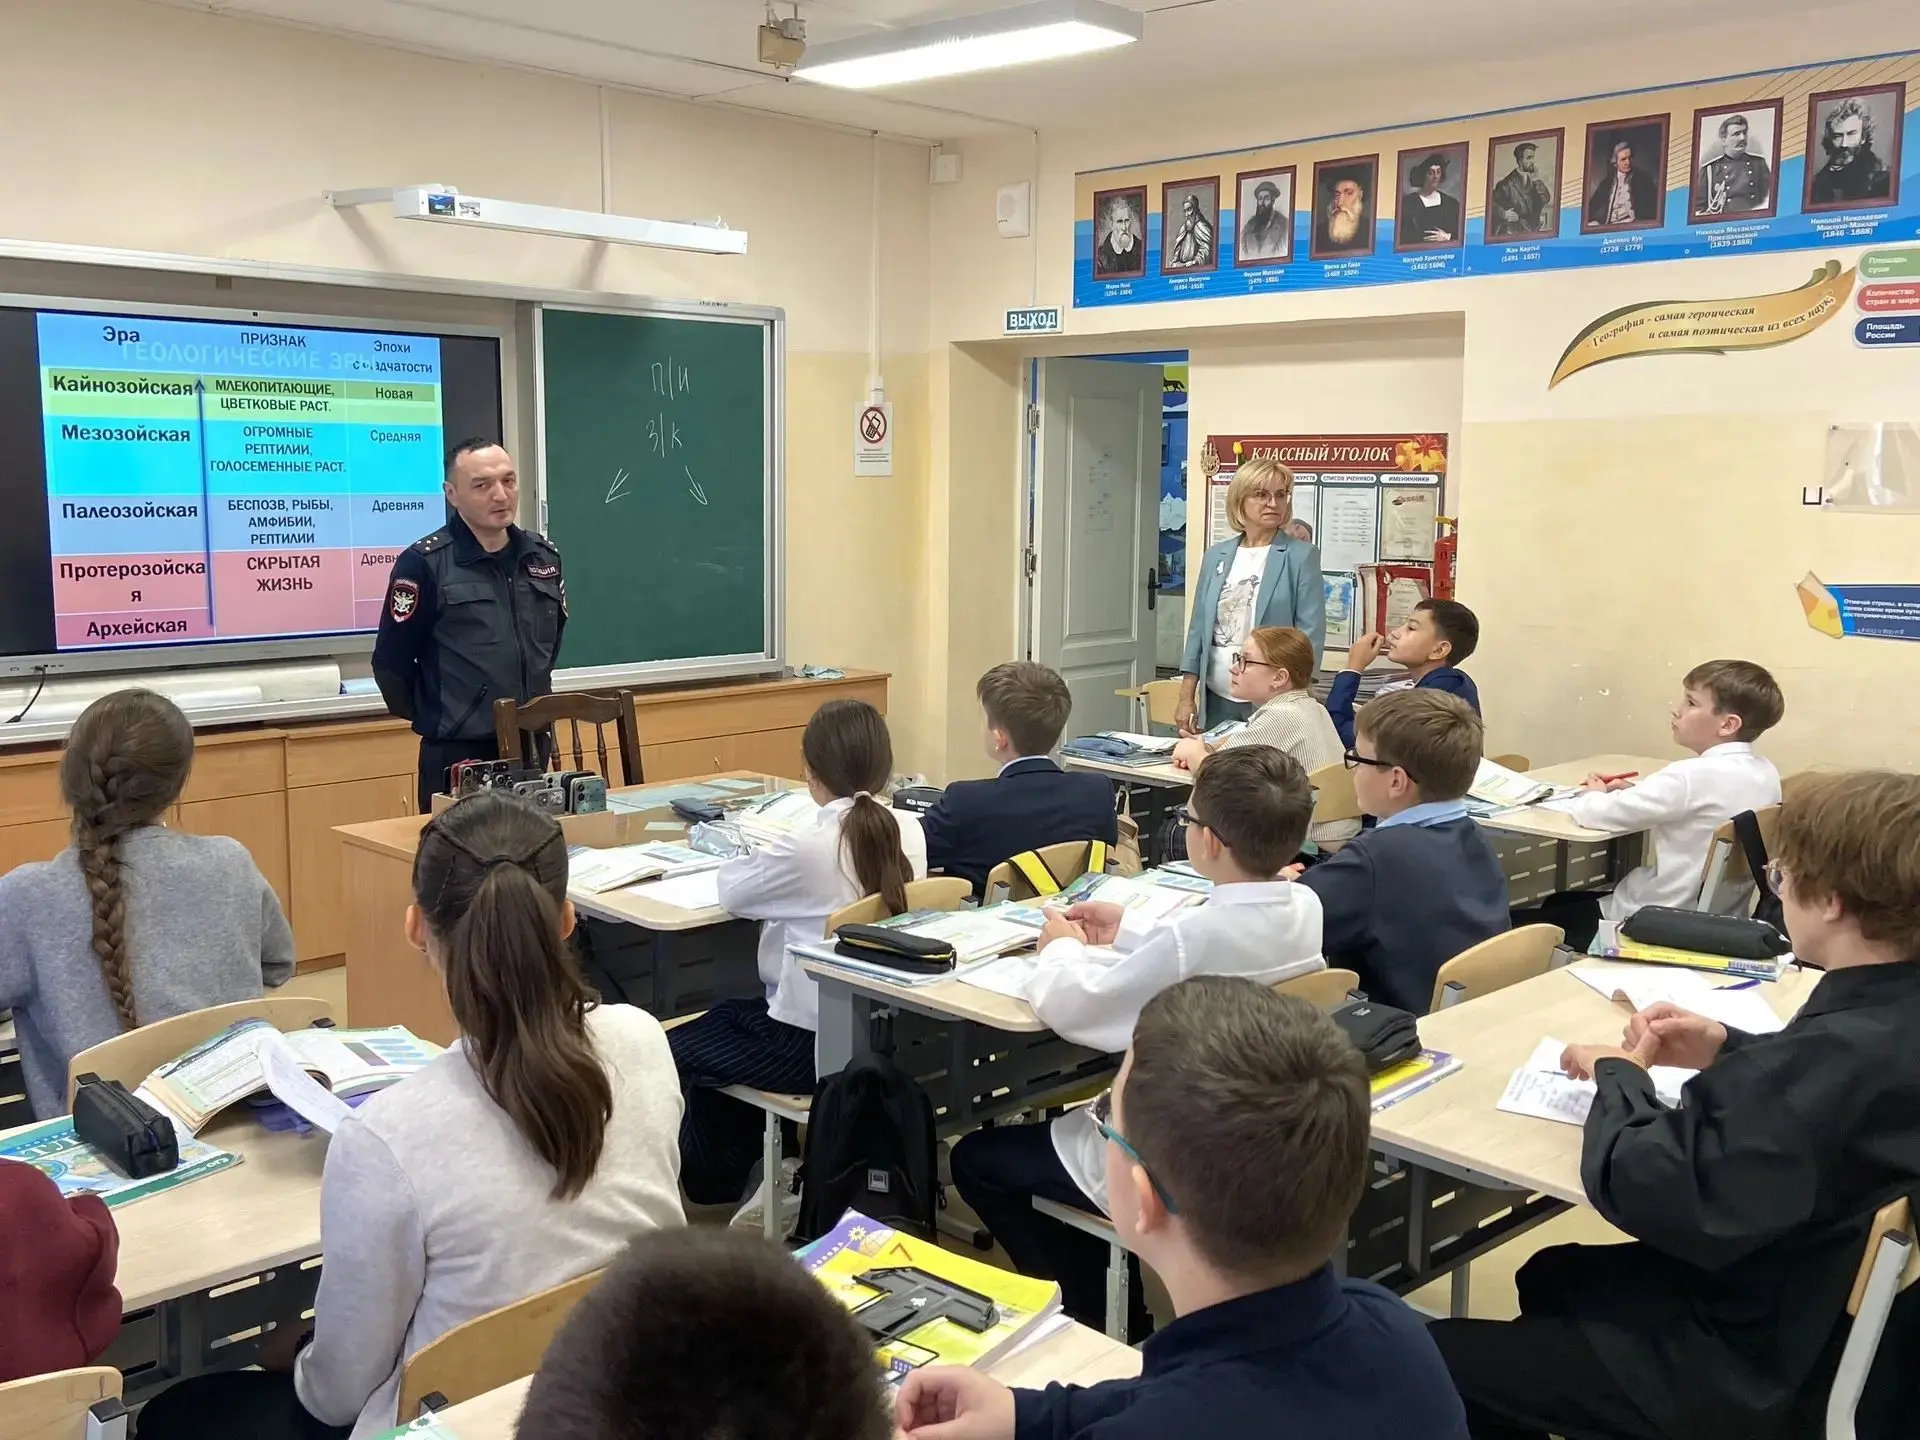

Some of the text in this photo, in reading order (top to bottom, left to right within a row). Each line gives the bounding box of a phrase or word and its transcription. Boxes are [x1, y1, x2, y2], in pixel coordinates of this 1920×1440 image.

[1009, 311, 1057, 330] ВЫХОД
[1593, 317, 1645, 347] География
[1654, 311, 1686, 321] самая
[1687, 306, 1755, 321] героическая
[1648, 331, 1656, 339] и
[1658, 328, 1690, 337] самая
[1692, 324, 1764, 336] поэтическая
[1767, 322, 1780, 331] из
[1782, 316, 1806, 328] всех
[1866, 323, 1905, 332] Площадь
[103, 325, 140, 346] Эра
[240, 332, 306, 348] ПРИЗНАК
[374, 340, 411, 353] Эпохи
[121, 340, 320, 370] ГЕОЛОГИЧЕСКИЕ
[53, 375, 193, 396] Кайнозойская
[215, 379, 335, 397] МЛЕКОПИТАЮЩИЕ,
[375, 387, 413, 400] Новая
[220, 397, 332, 412] ЦВЕТКОВЫЕ РАСТ.
[61, 424, 191, 442] Мезозойская
[243, 426, 314, 438] ОГРОМНЫЕ
[370, 430, 421, 443] Средняя
[245, 443, 313, 456] РЕПТИЛИИ,
[1251, 443, 1393, 462] КЛАССНЫЙ УГОЛОК
[210, 460, 346, 473] ГОЛОСЕМЕННЫЕ РАСТ.
[62, 501, 198, 519] Палеозойская
[228, 499, 334, 511] БЕСПОЗВ, РЫБЫ,
[372, 499, 424, 513] Древняя
[248, 516, 316, 528] АМФИБИИ,
[251, 533, 315, 545] РЕПТИЛИИ
[60, 559, 206, 581] Протерозойска
[246, 555, 321, 571] СКРЫТАЯ
[256, 577, 313, 592] ЖИЗНЬ
[130, 590, 142, 602] я
[86, 618, 188, 640] Архейская
